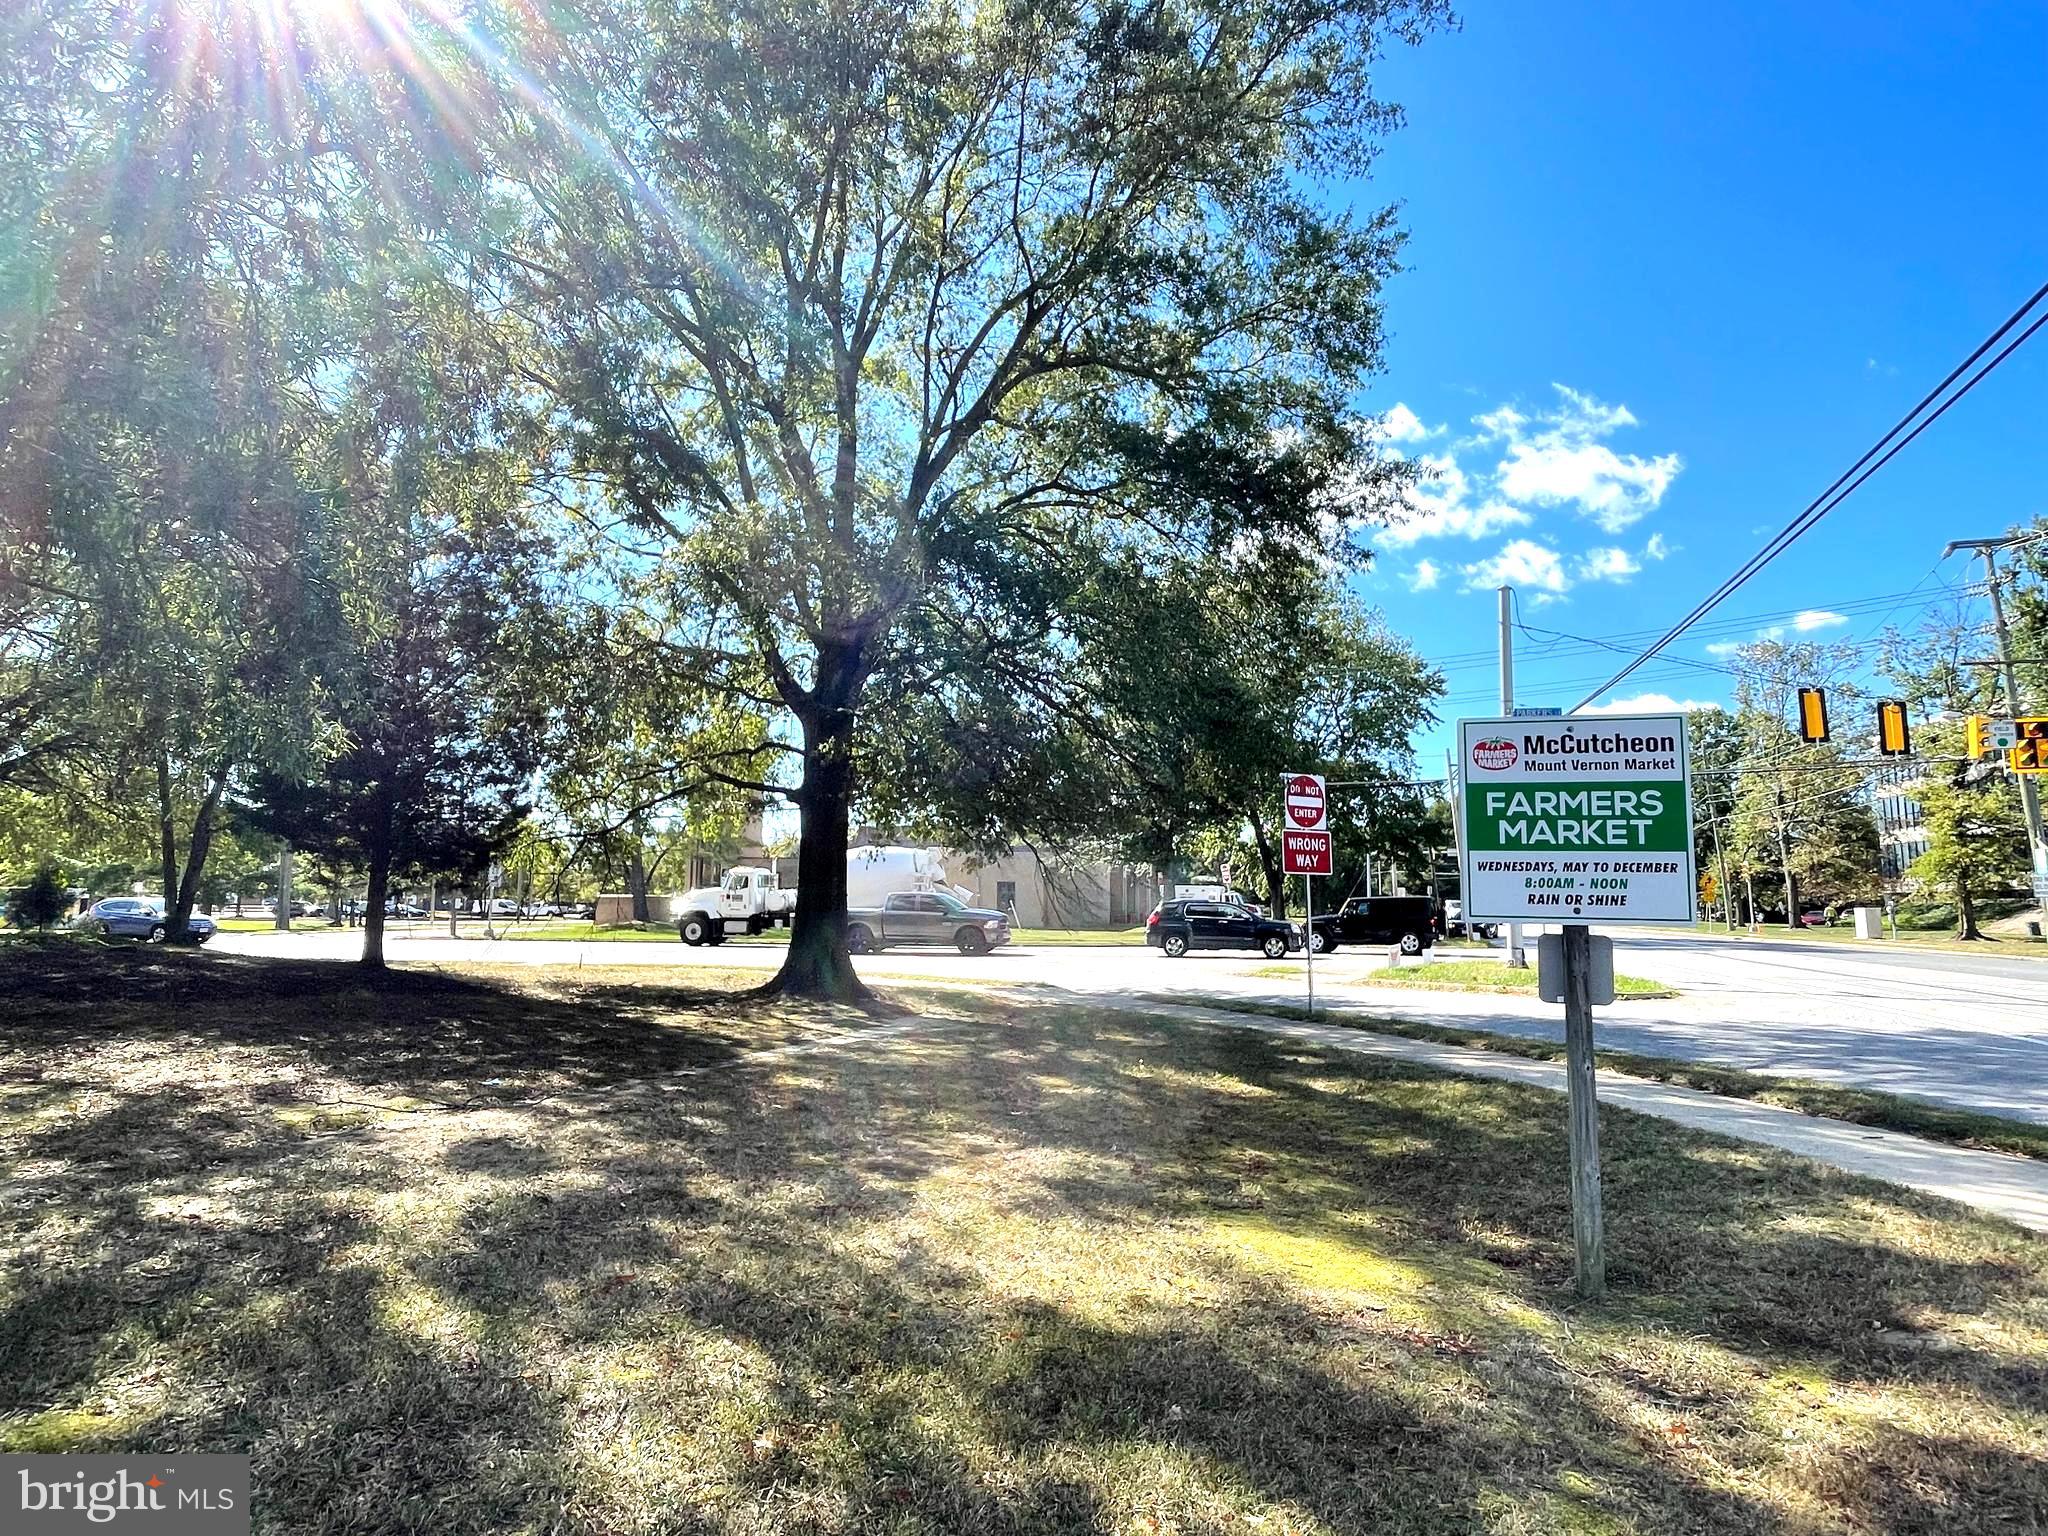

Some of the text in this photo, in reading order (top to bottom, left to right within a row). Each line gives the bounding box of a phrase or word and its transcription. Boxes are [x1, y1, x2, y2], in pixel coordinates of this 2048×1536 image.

[1524, 733, 1675, 755] McCutcheon
[1474, 749, 1517, 759] FARMERS
[1478, 758, 1513, 768] MARKET
[1524, 757, 1676, 772] Mount Vernon Market
[1290, 784, 1320, 796] DO NOT
[1486, 789, 1664, 817] FARMERS
[1294, 808, 1317, 818] ENTER
[1499, 819, 1653, 845] MARKET
[1288, 837, 1327, 852] WRONG
[1296, 854, 1319, 867] WAY
[1477, 861, 1679, 874] WEDNESDAYS, MAY TO DECEMBER
[1524, 877, 1575, 889] 8:00AM
[1589, 878, 1629, 889] NOON
[1527, 894, 1627, 906] RAIN OR SHINE
